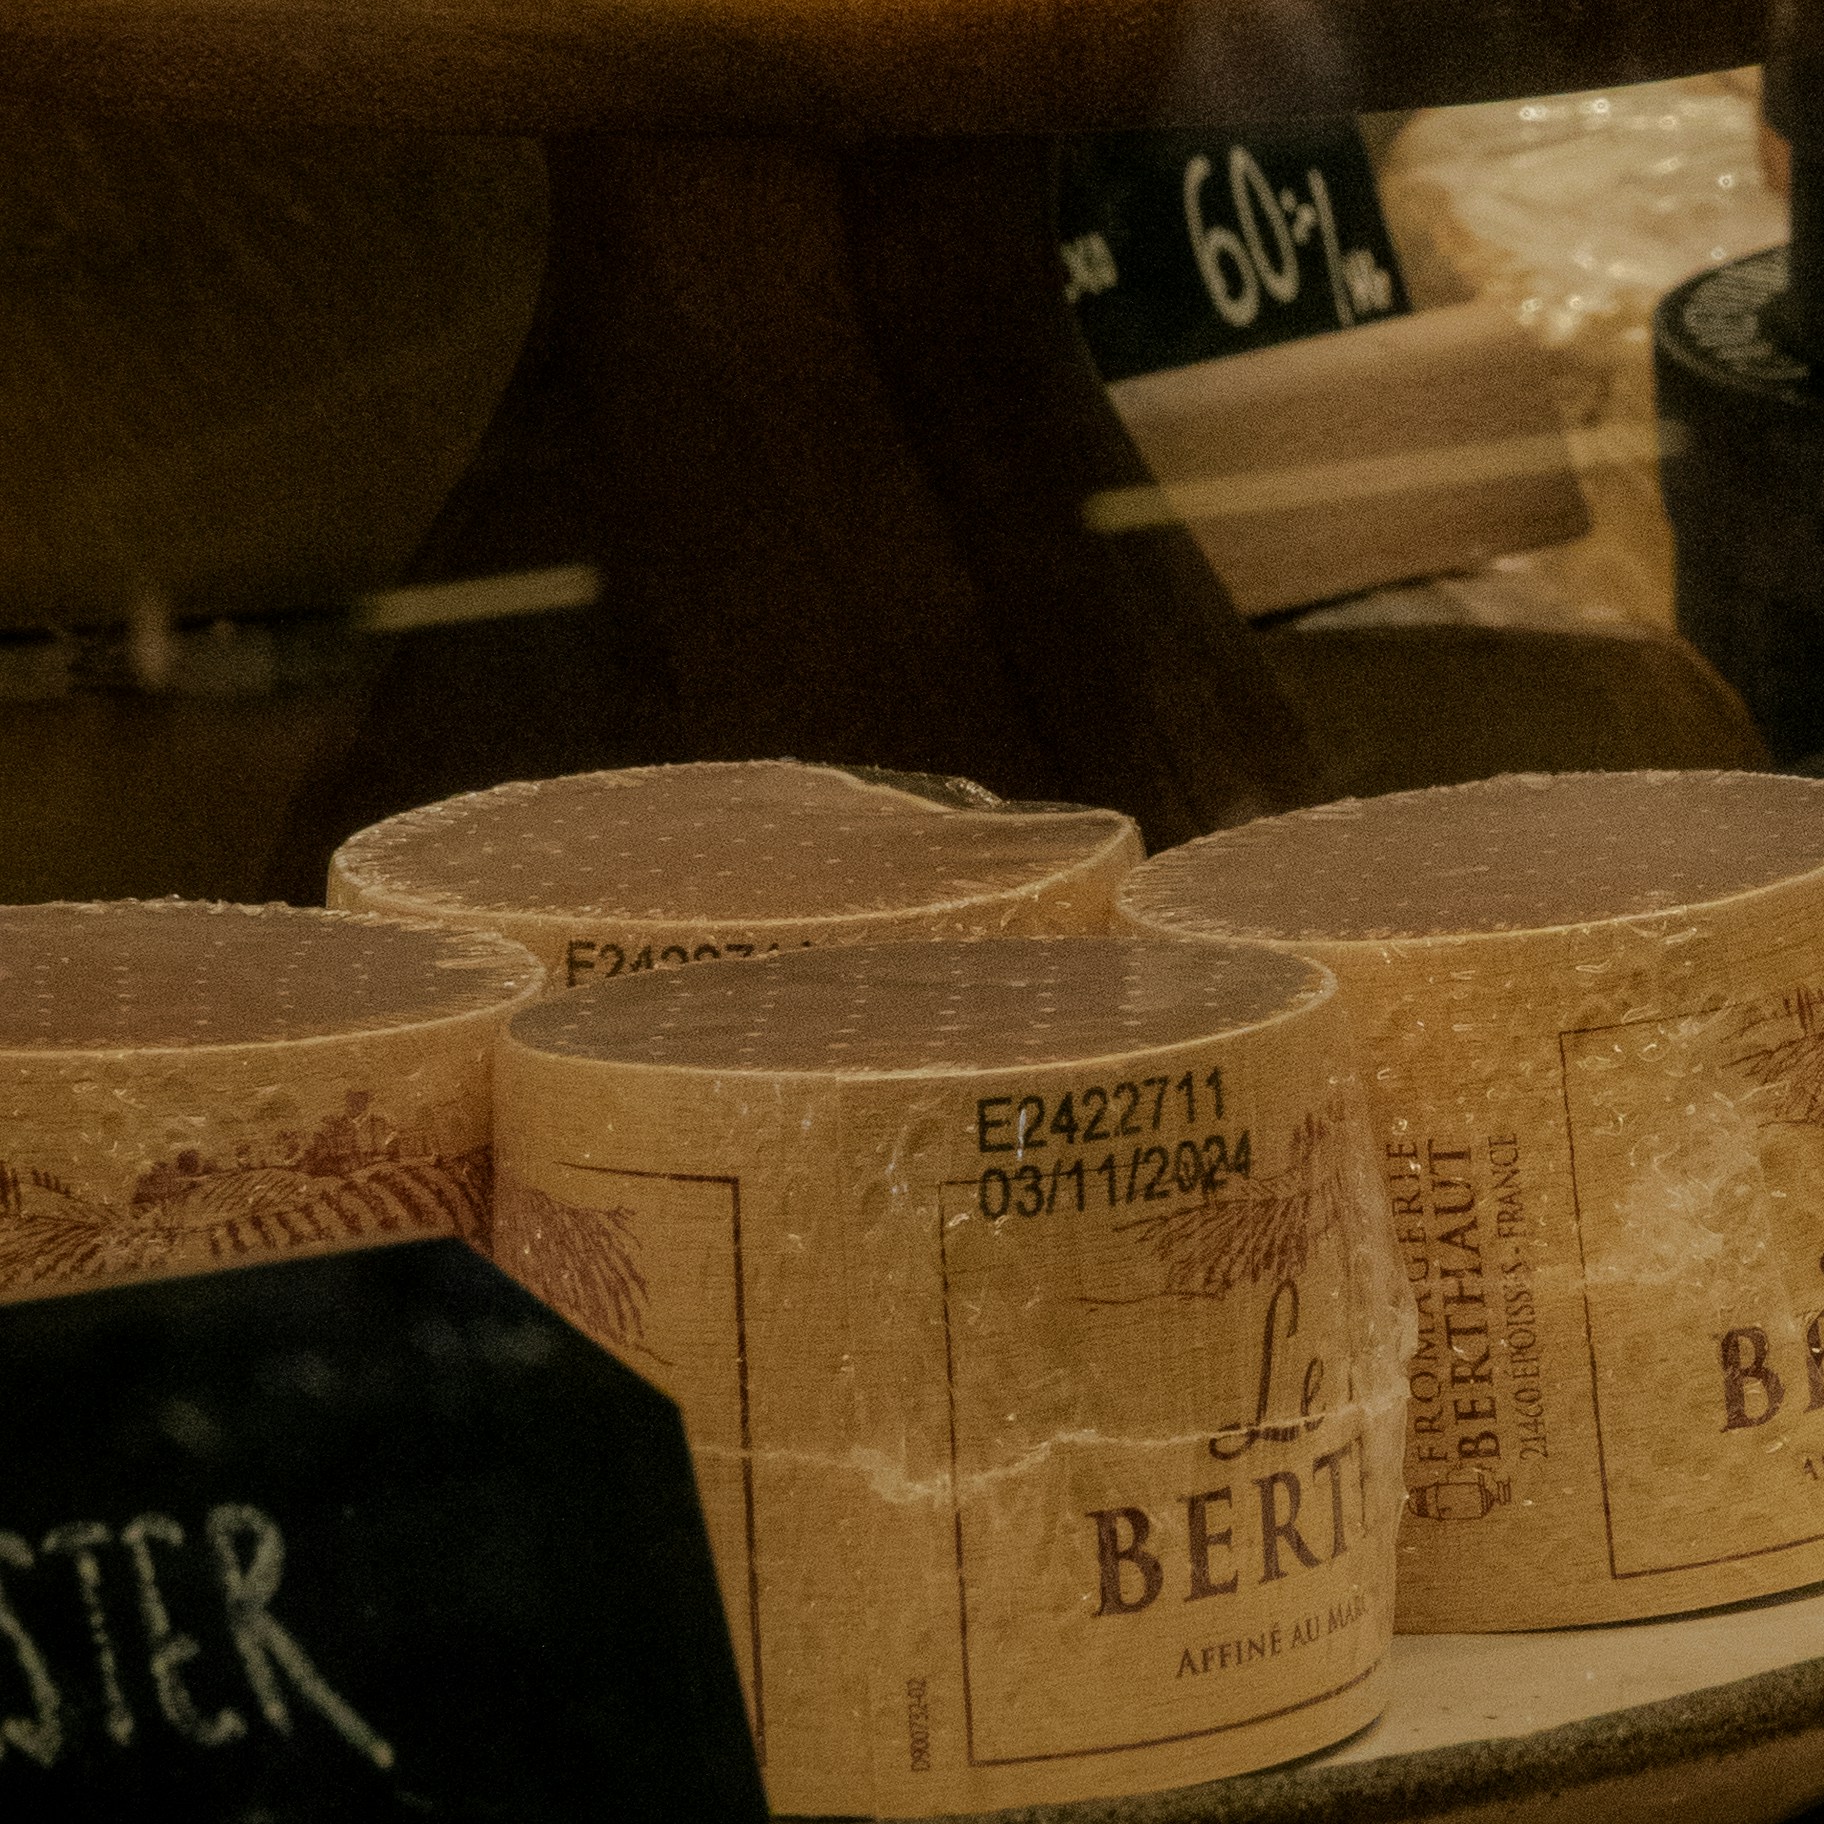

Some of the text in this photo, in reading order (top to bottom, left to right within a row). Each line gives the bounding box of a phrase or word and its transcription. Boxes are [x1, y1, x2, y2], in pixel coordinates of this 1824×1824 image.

[976, 1068, 1228, 1154] E2422711
[978, 1129, 1255, 1222] 03/11/2024
[1488, 1131, 1526, 1239] FRANCE
[1385, 1140, 1449, 1464] FROMAGERIE
[1427, 1136, 1501, 1461] BERTHAUT
[1208, 1278, 1327, 1462] Le
[1290, 1613, 1322, 1649] AU
